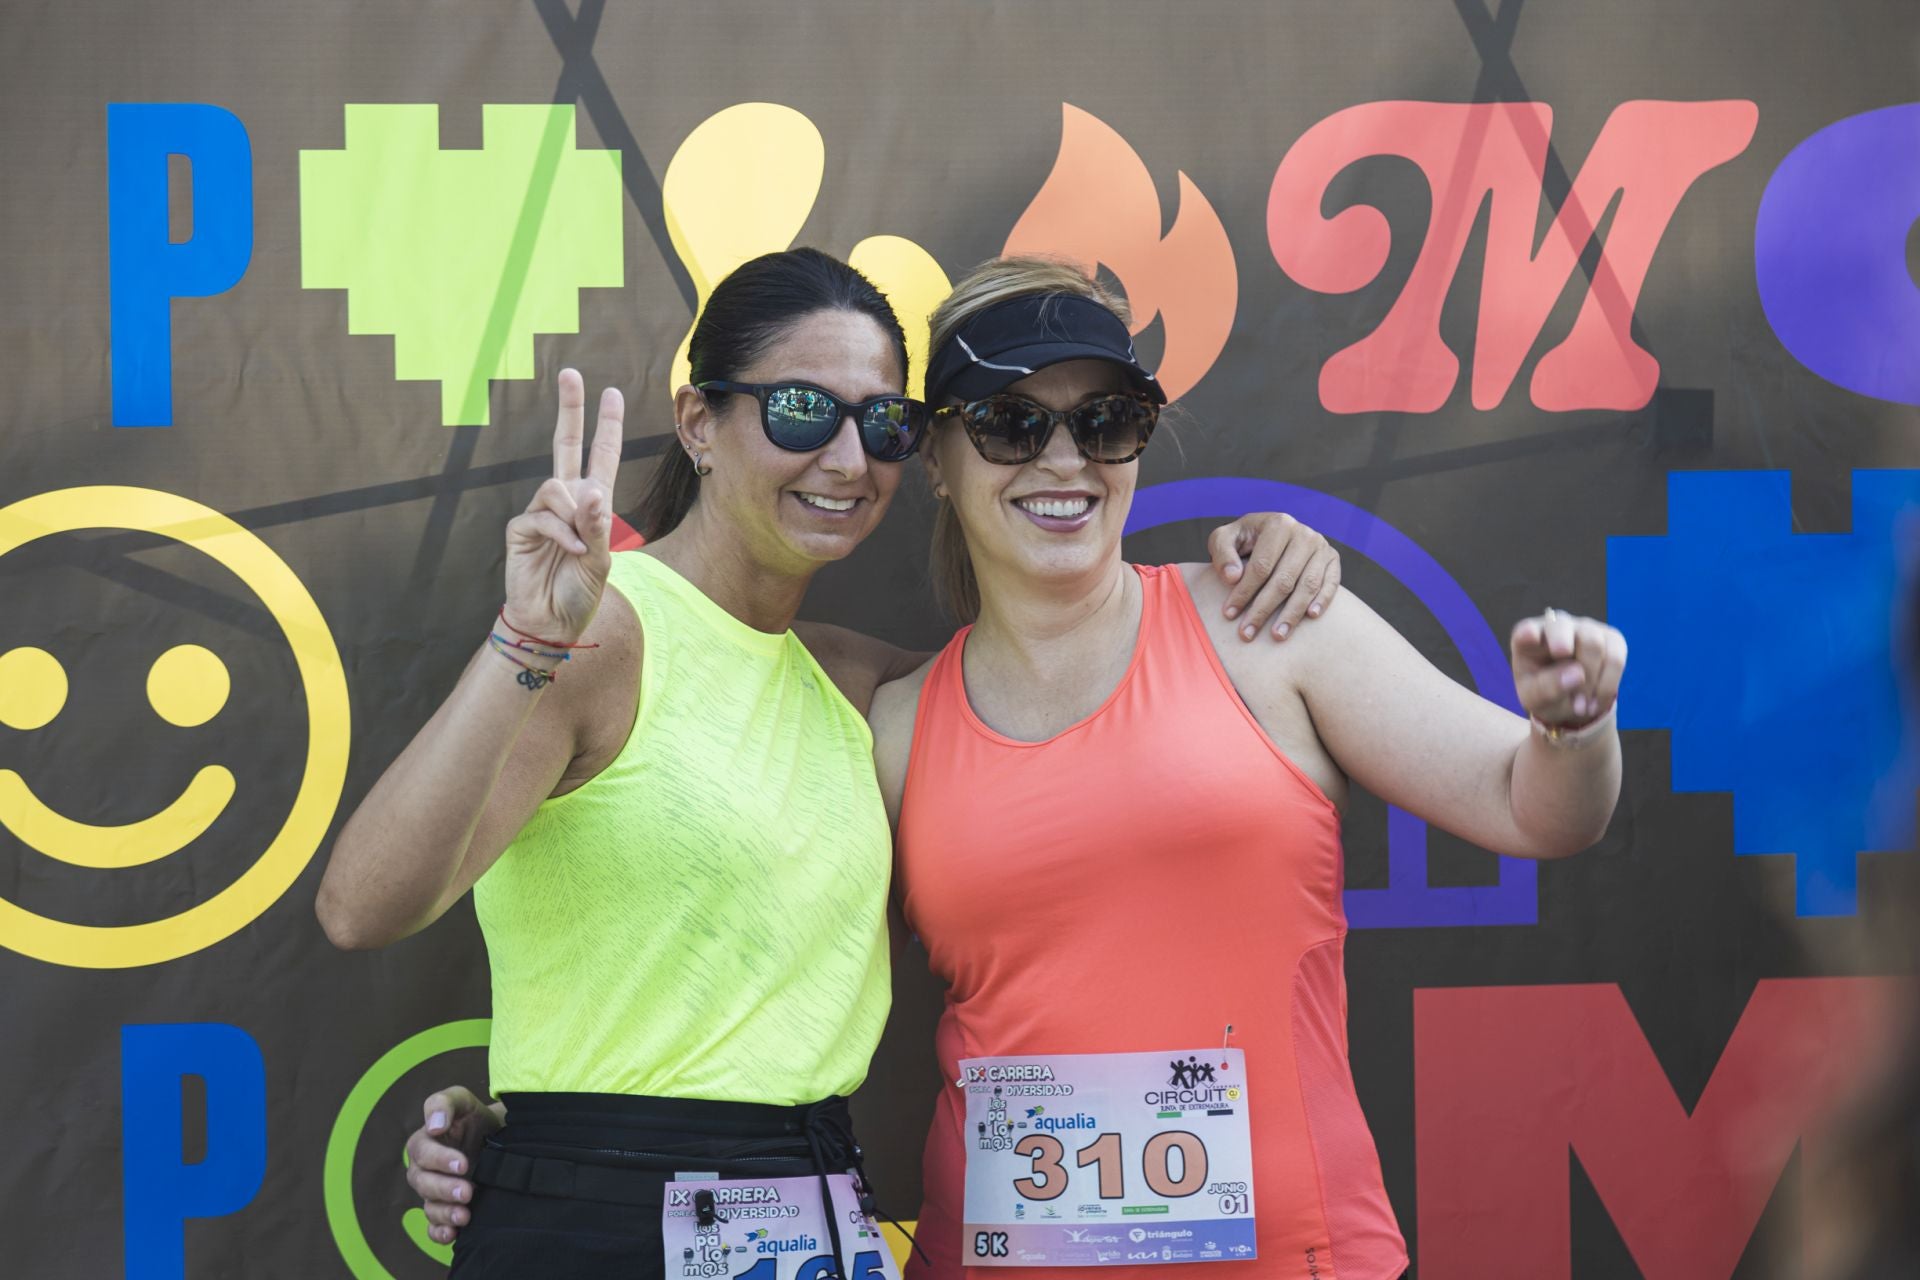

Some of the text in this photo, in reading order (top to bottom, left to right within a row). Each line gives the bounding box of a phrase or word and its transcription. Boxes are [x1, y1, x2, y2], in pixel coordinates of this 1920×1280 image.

[967, 1065, 1055, 1082] IX CARRERA
[1005, 1084, 1074, 1096] DIVERSIDAD
[1189, 1102, 1229, 1110] EXTREMADURA
[988, 1110, 1007, 1126] pa
[1034, 1113, 1096, 1133] aqualia
[992, 1121, 1009, 1136] lo
[980, 1136, 1013, 1151] m@s
[1013, 1130, 1208, 1201] 310
[1208, 1182, 1247, 1194] JUNIO
[669, 1189, 690, 1206] IX
[1218, 1194, 1249, 1215] 01
[716, 1206, 800, 1220] DIVERSIDAD
[694, 1234, 720, 1252] pa
[756, 1234, 817, 1256] aqualia
[975, 1231, 1009, 1257] 5K
[703, 1246, 722, 1262] lo
[683, 1262, 729, 1278] m@s
